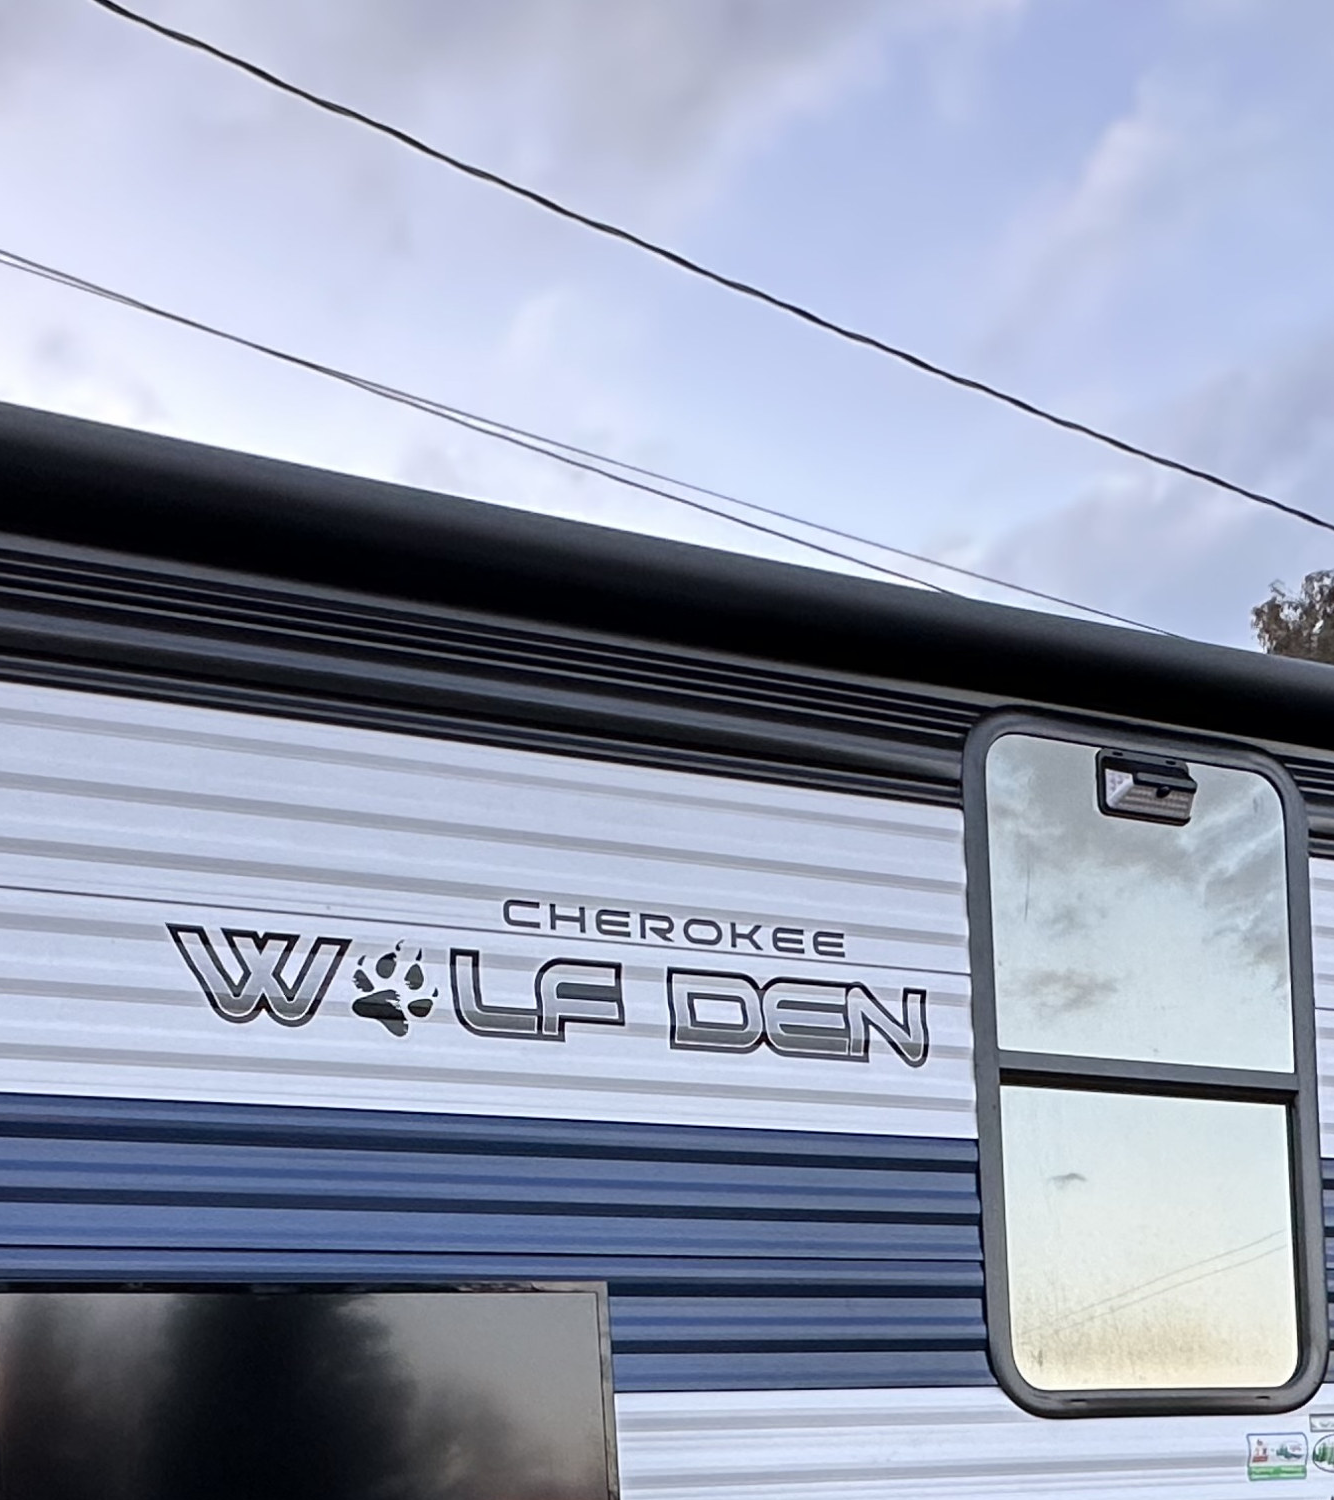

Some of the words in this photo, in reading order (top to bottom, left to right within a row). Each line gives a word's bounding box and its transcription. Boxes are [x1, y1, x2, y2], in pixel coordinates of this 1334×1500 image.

[502, 898, 846, 958] CHEROKEE
[165, 922, 626, 1042] WLF
[666, 965, 929, 1069] DEN
